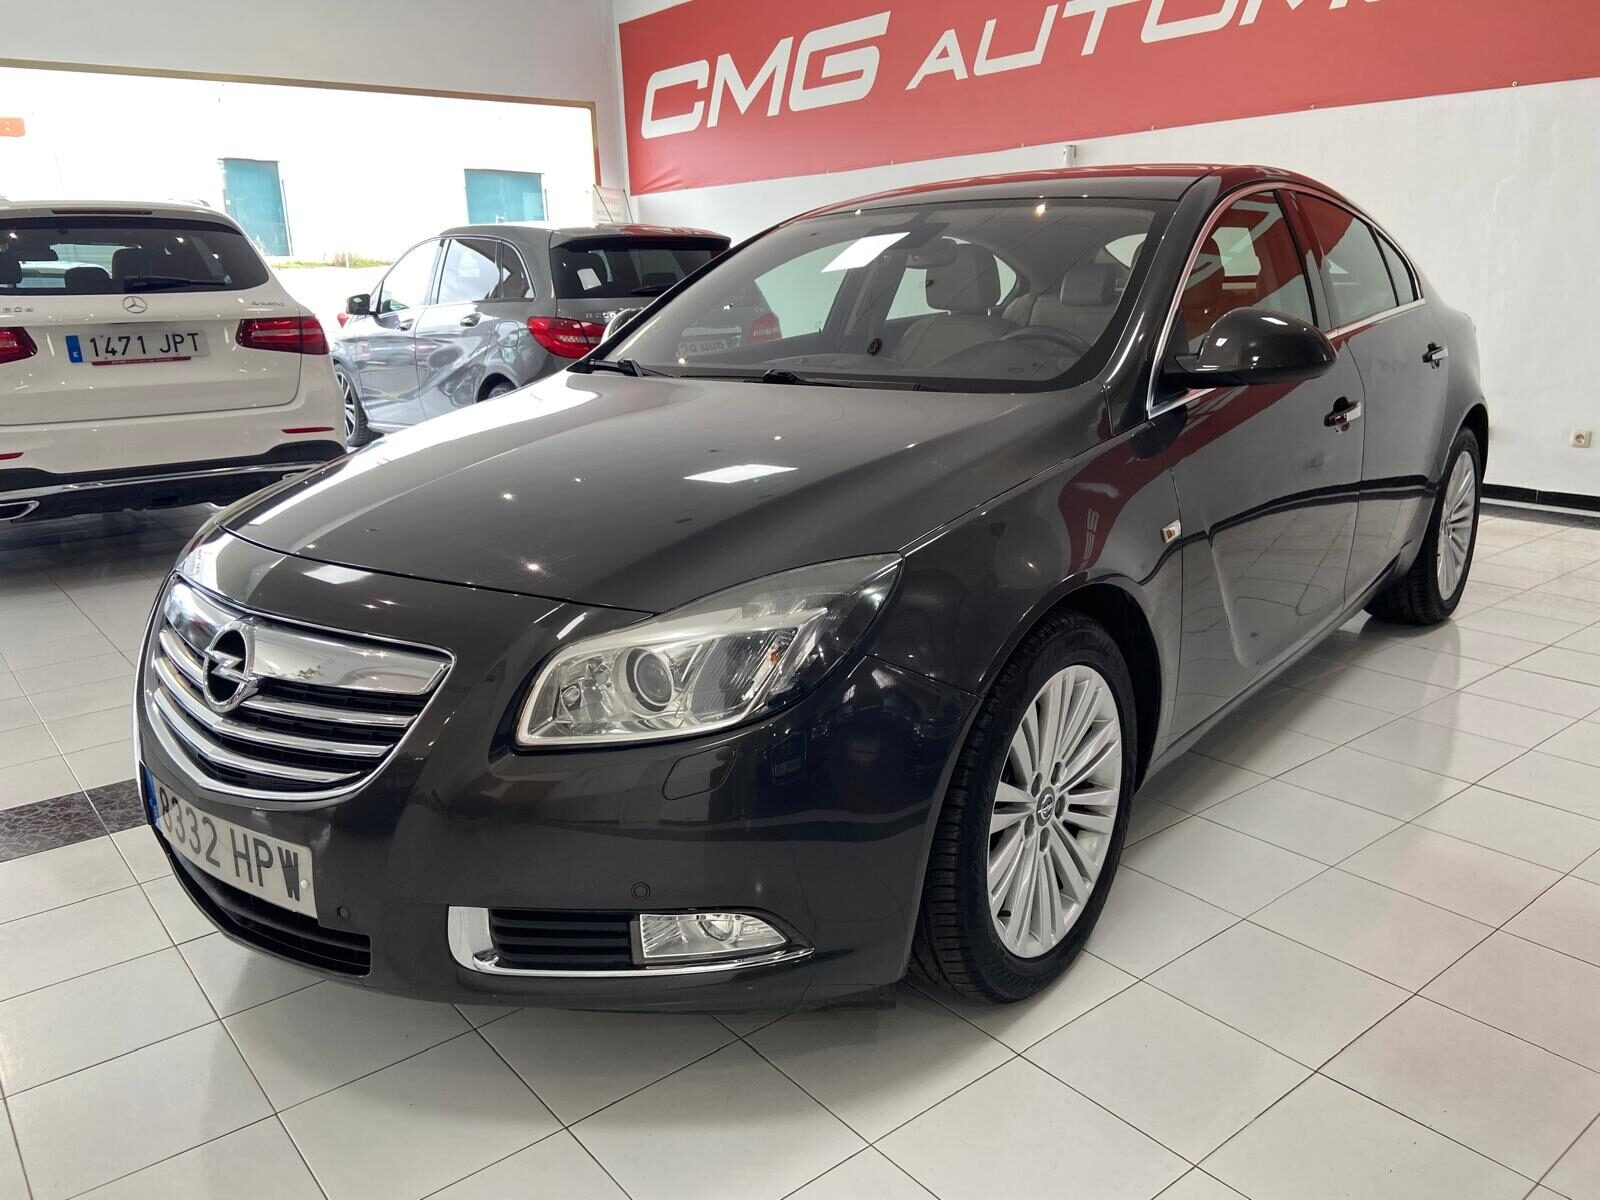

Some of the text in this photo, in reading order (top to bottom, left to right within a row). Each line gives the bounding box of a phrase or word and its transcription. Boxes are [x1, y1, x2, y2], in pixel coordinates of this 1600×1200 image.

[641, 10, 891, 140] CMG
[90, 335, 147, 357] 1471
[160, 332, 199, 354] JPT
[159, 786, 300, 902] 8332 HPW
